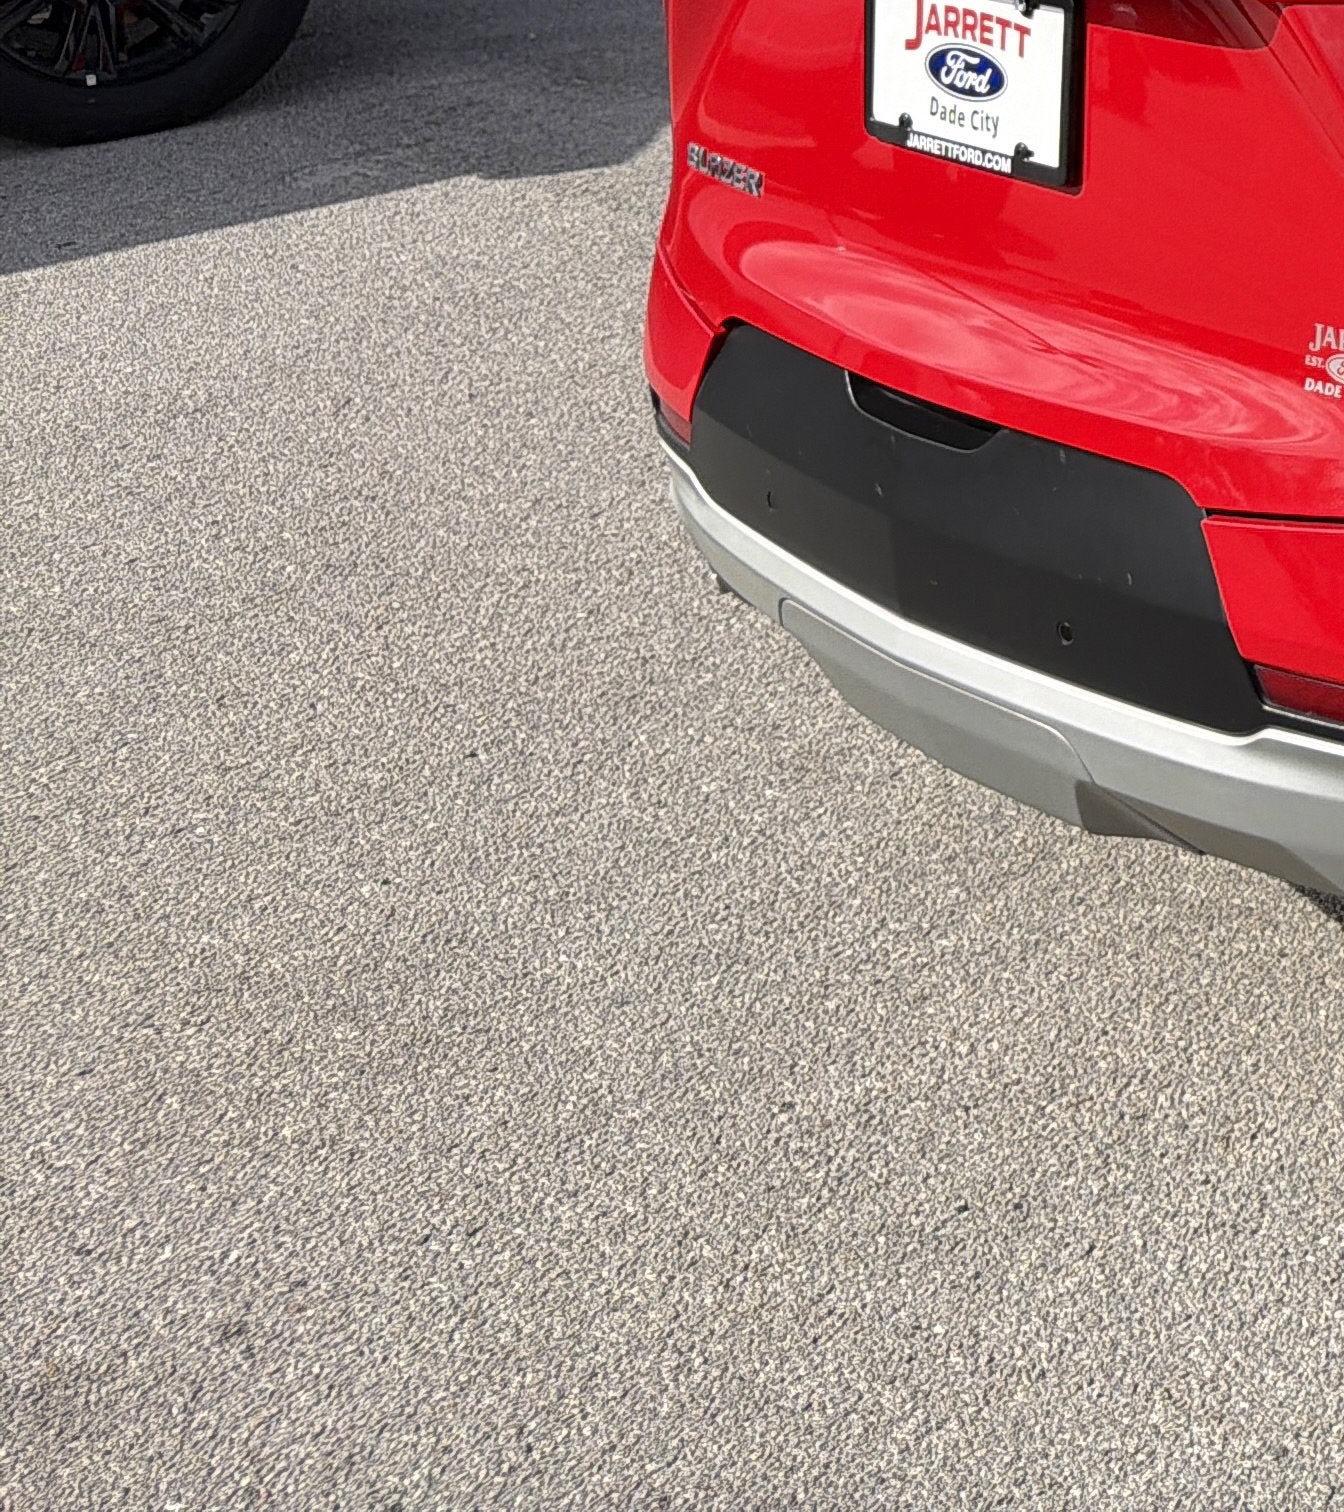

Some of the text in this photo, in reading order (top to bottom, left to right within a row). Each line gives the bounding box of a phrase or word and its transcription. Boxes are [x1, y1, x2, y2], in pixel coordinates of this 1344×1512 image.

[940, 50, 992, 94] Ford
[929, 95, 1000, 138] Dade City
[687, 141, 766, 199] BLAZER
[906, 132, 1012, 174] JARRETTFORD.COM
[1304, 354, 1326, 369] EST.
[1304, 377, 1343, 399] DADE
